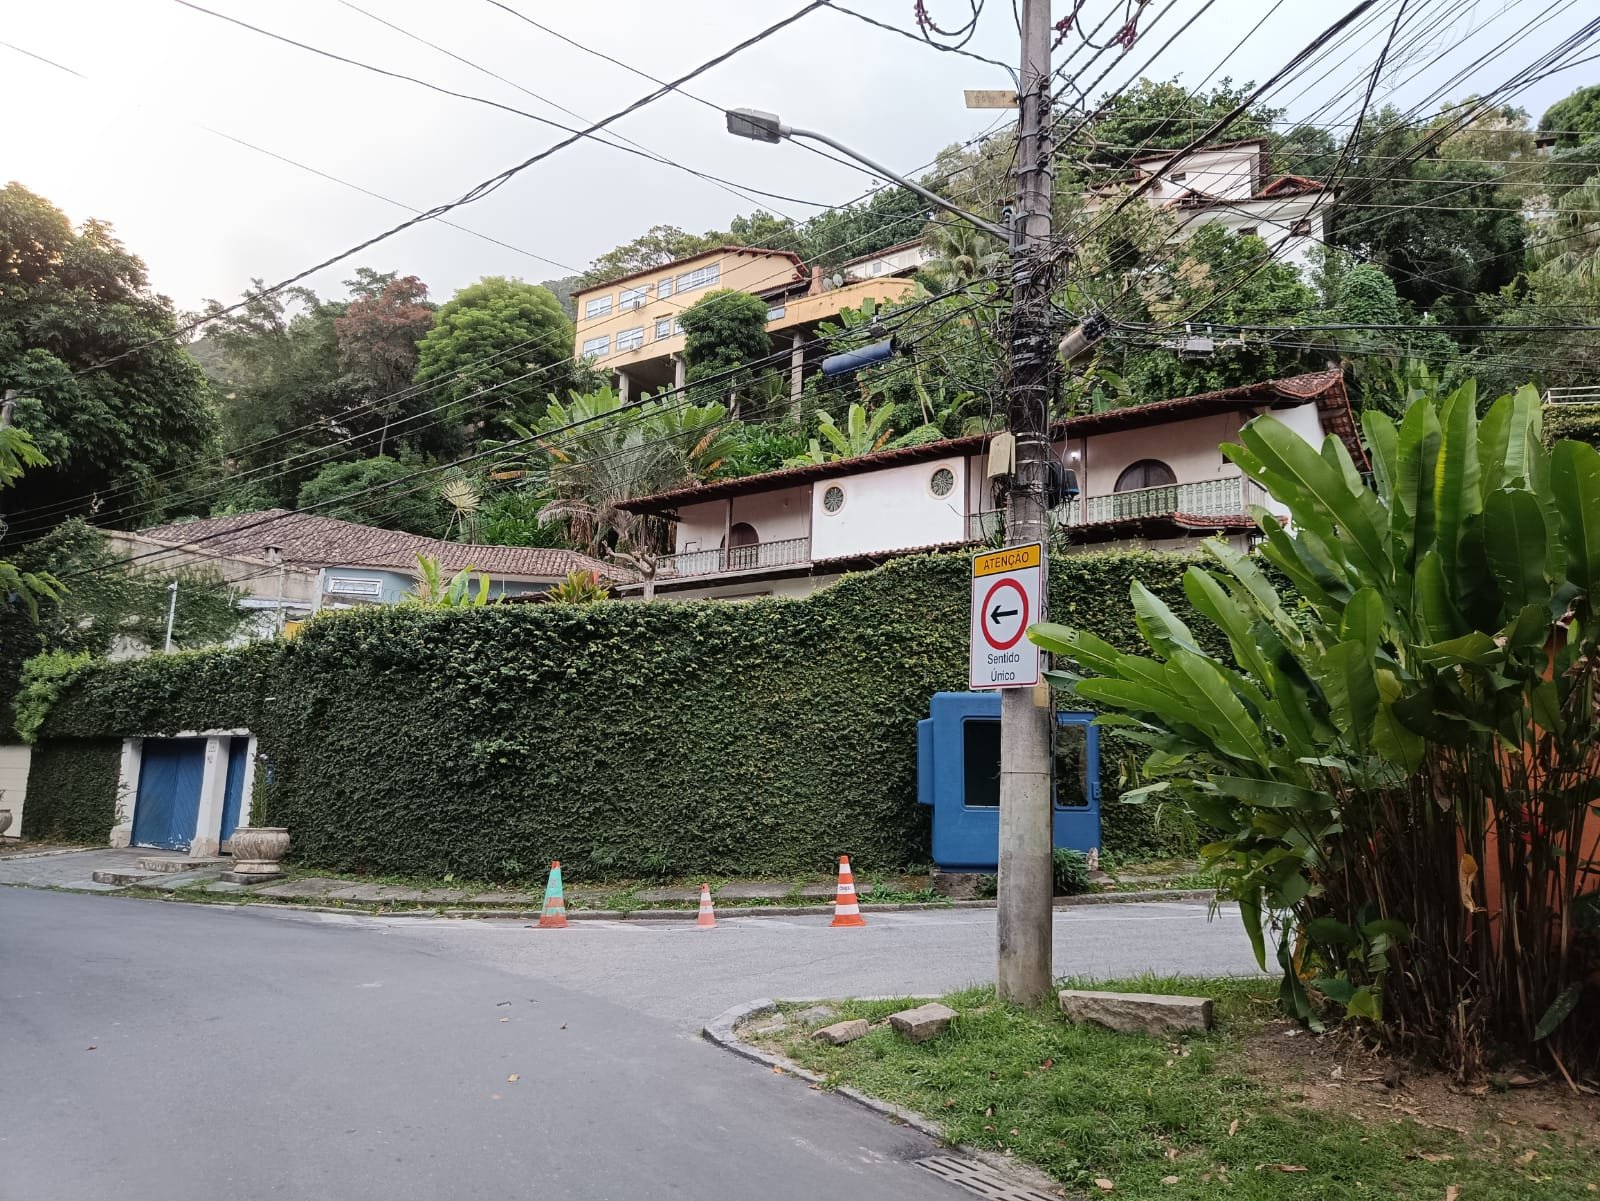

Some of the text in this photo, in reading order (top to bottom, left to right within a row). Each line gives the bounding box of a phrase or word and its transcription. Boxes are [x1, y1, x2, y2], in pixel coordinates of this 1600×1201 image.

[984, 551, 1029, 570] ATENÇÃO
[987, 652, 1020, 665] Sentido
[990, 668, 1015, 682] Único
